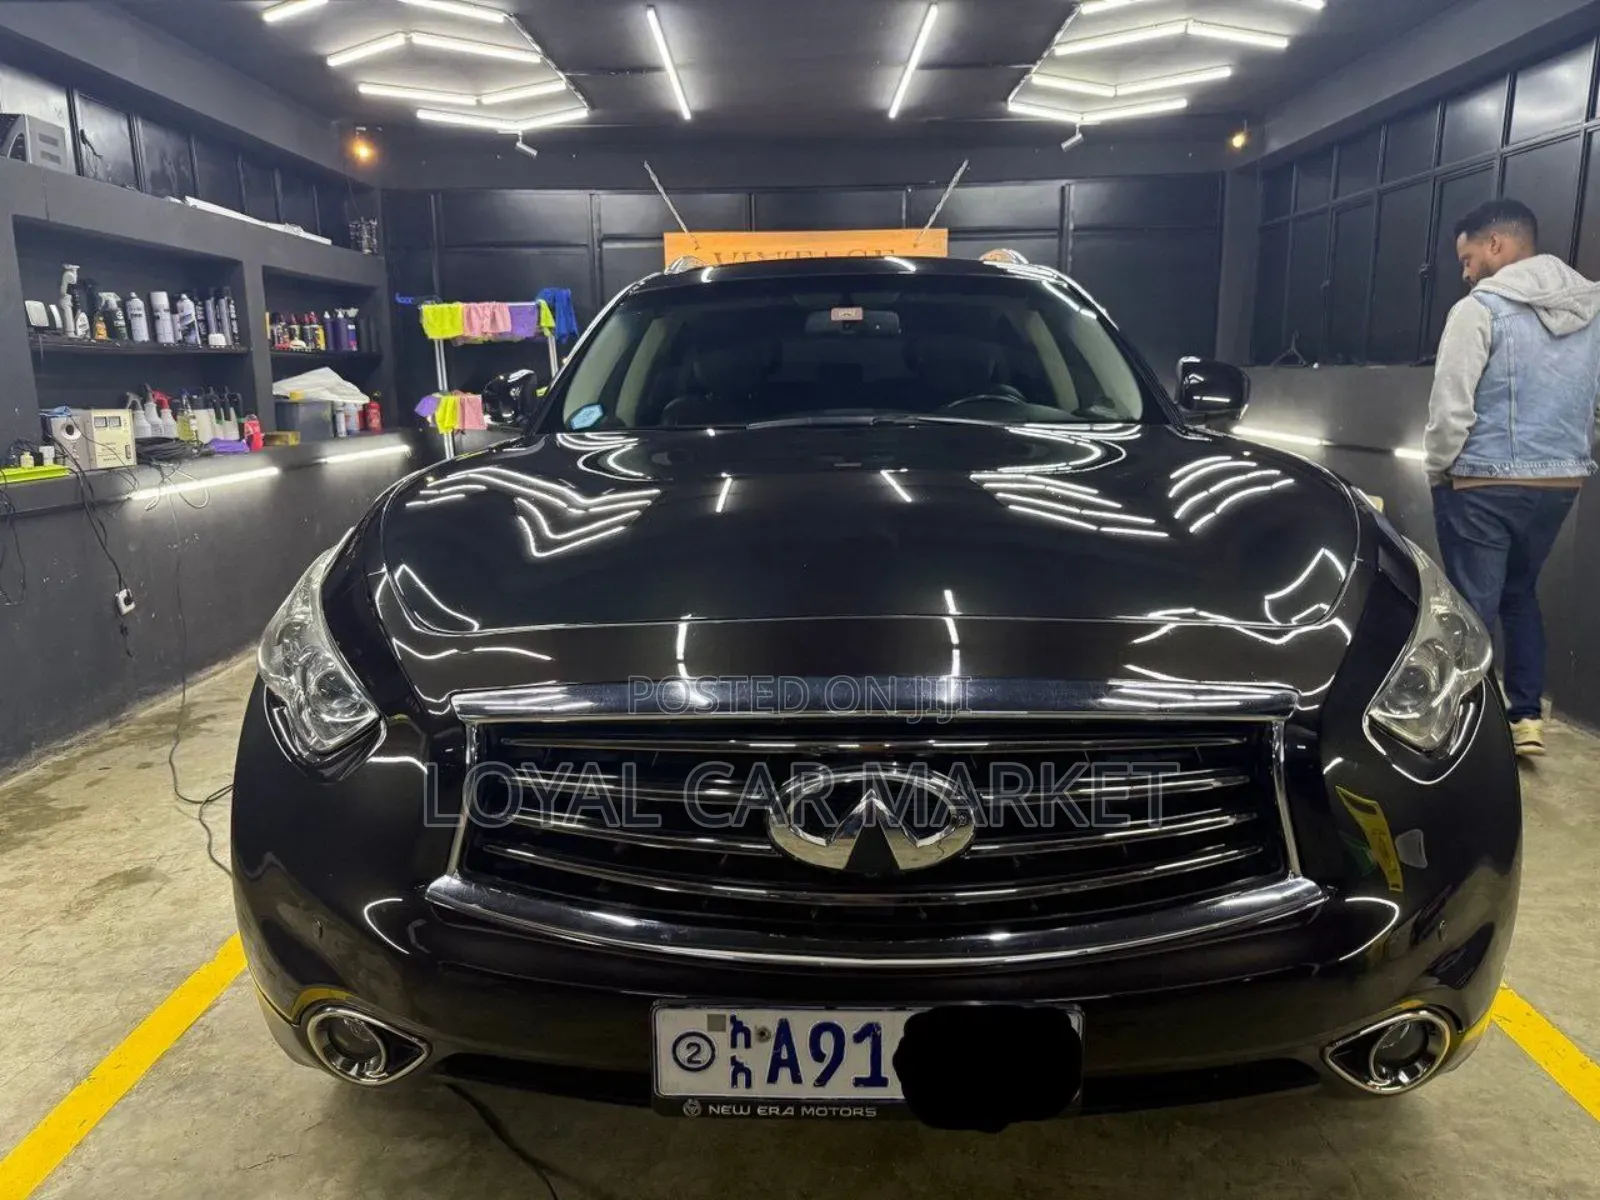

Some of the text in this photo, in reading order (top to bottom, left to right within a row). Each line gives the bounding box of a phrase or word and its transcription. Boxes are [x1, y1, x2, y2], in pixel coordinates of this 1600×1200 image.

[708, 1104, 877, 1118] NEW ERA MOTORS
